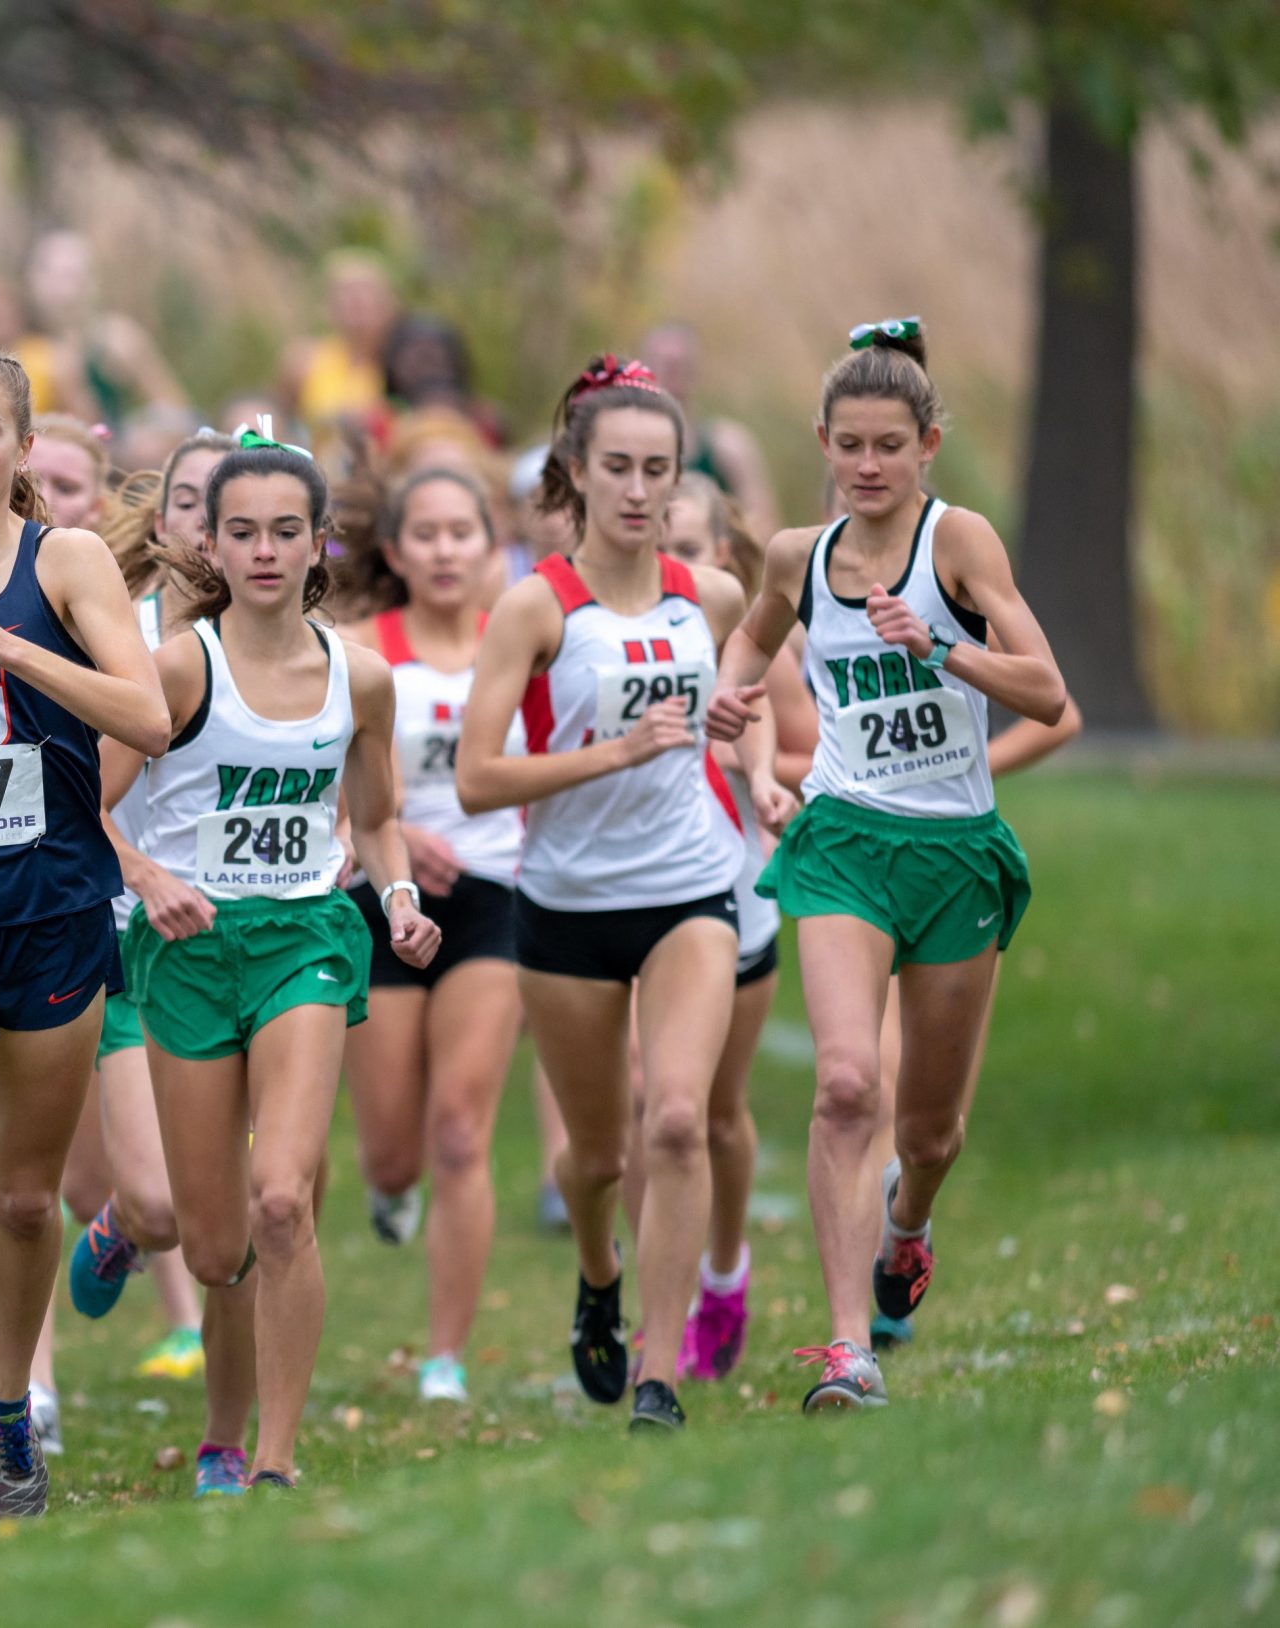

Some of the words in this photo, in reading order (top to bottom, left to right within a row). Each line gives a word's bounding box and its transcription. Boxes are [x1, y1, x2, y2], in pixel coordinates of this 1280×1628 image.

[860, 702, 947, 760] 249
[853, 746, 970, 781] LAKESHORE
[216, 764, 337, 811] YORK
[223, 816, 308, 865] 248
[204, 871, 321, 884] LAKESHORE
